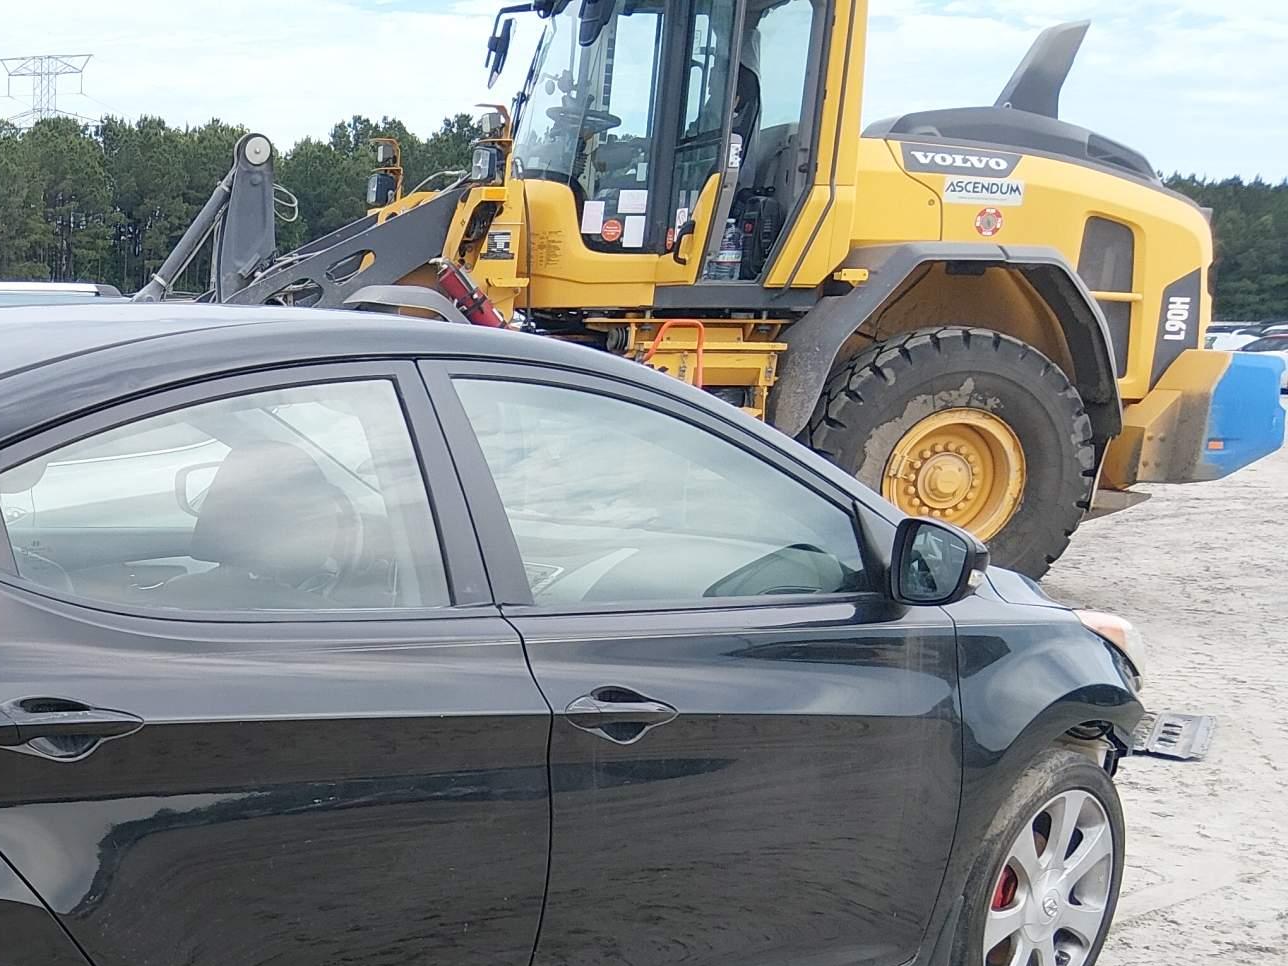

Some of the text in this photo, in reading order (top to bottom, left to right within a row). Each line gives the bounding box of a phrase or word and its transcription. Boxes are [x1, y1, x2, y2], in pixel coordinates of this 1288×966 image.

[910, 151, 1008, 171] VOLVO
[944, 180, 1022, 196] ASCENDUM
[1163, 296, 1192, 341] L90H
